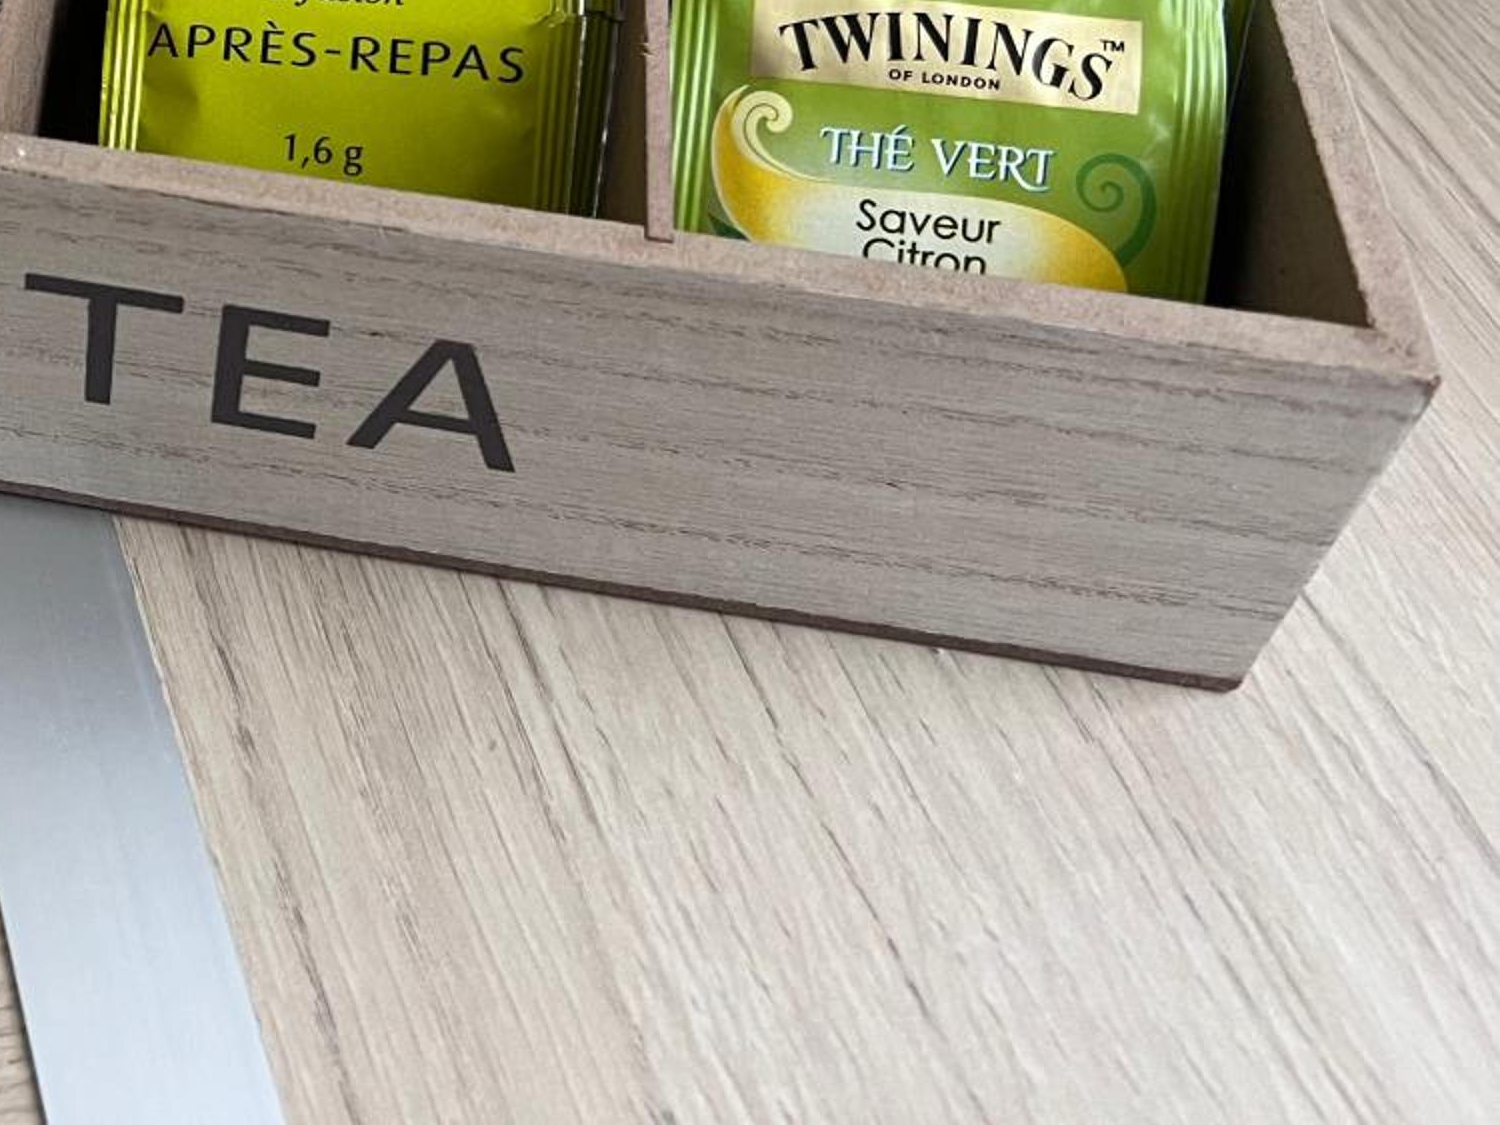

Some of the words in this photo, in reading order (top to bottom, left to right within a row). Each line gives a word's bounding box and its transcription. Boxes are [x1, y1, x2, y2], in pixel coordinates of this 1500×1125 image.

[147, 20, 525, 84] APRÈS-REPAS
[778, 10, 1113, 101] TWININGS
[888, 68, 914, 82] OF
[921, 72, 1000, 91] LONDON
[284, 133, 334, 169] 1,6
[343, 143, 364, 176] g
[820, 125, 915, 173] THÉ
[931, 137, 1056, 193] VERT
[855, 198, 1001, 244] Saveur
[24, 272, 516, 473] TEA
